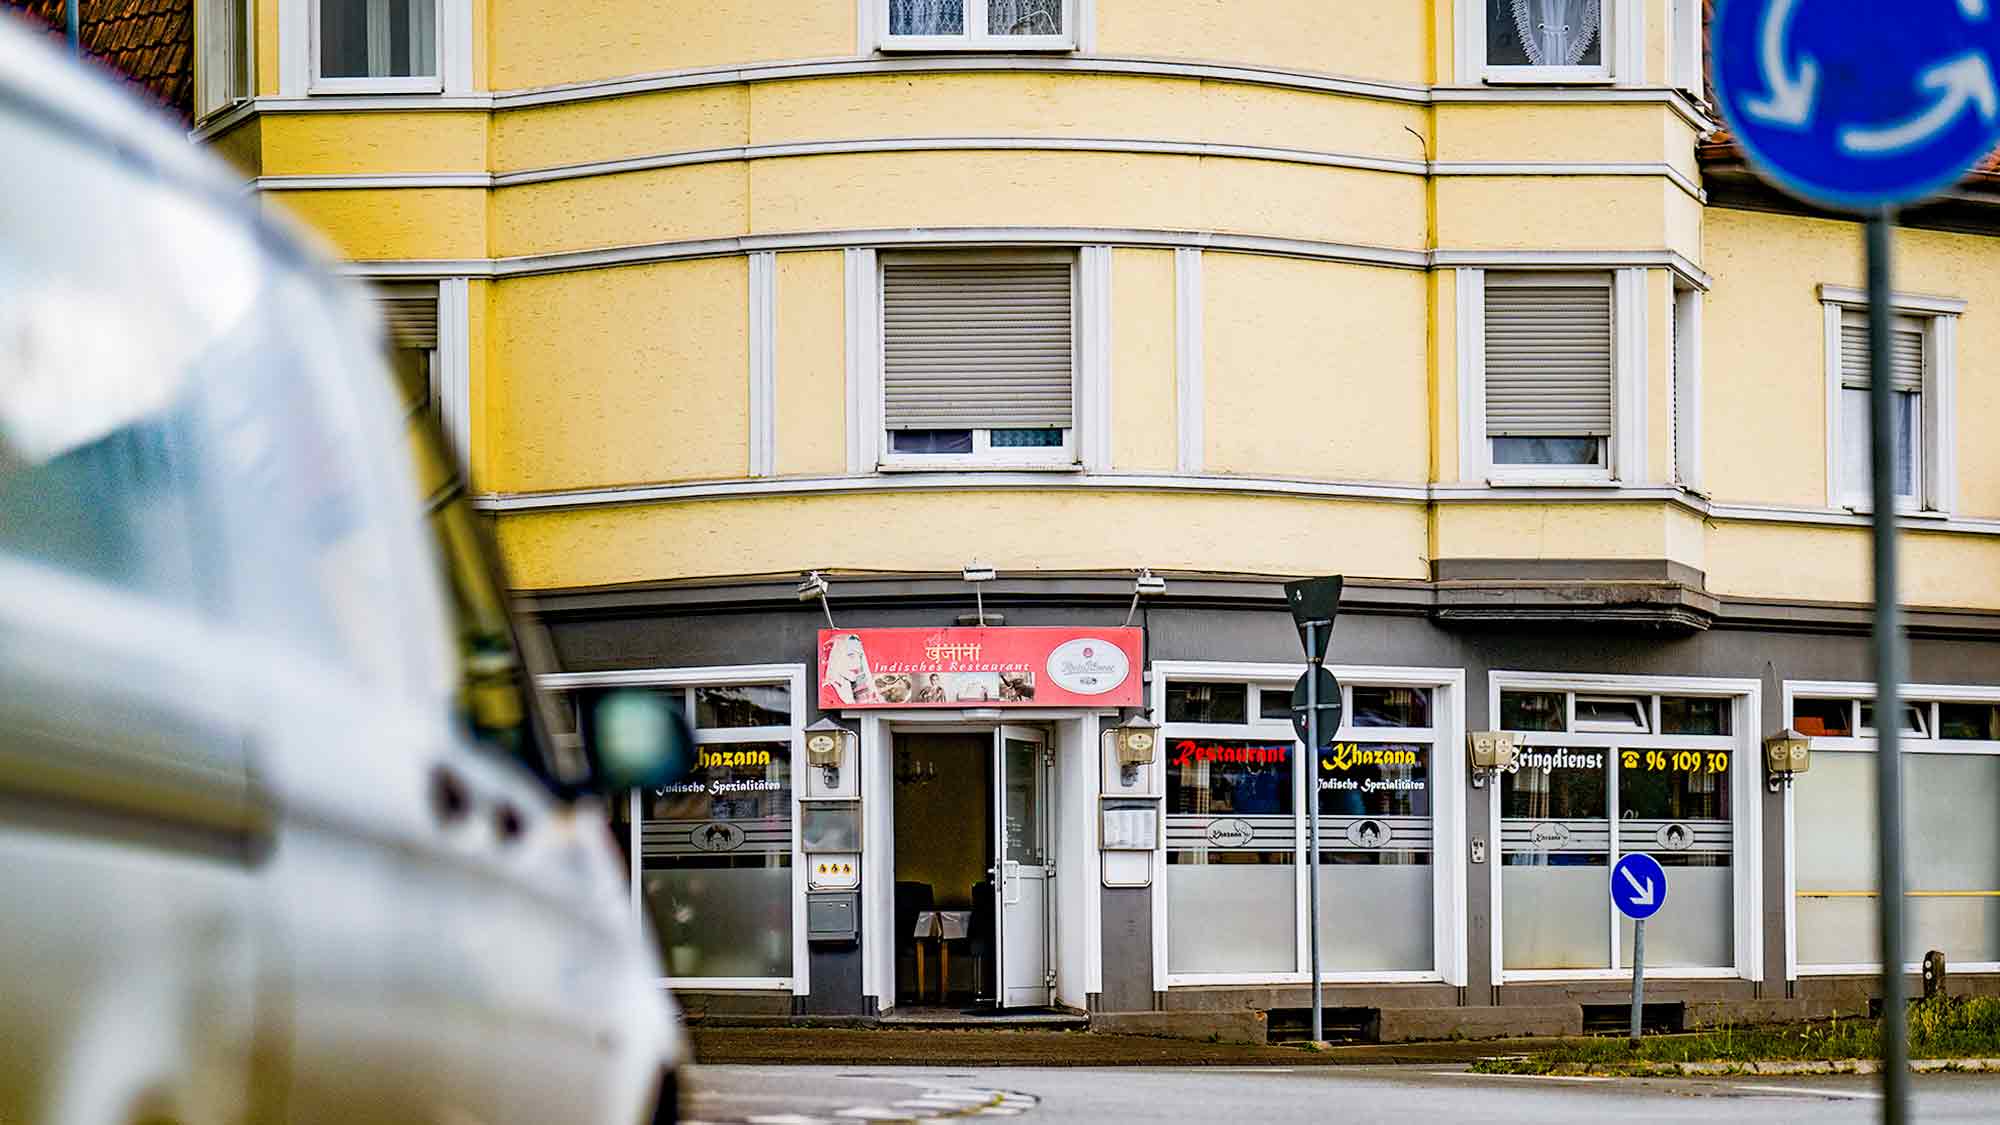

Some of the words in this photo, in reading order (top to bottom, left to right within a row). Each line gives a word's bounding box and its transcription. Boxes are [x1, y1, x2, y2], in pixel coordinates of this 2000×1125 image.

[874, 662, 943, 672] Indisches
[949, 662, 1031, 672] Restaurant
[690, 746, 771, 772] hazana
[1173, 740, 1287, 768] Restaurant
[1322, 743, 1416, 771] Khazana
[1646, 750, 1666, 771] 96
[1672, 751, 1701, 772] 109
[1706, 752, 1728, 773] 30
[708, 780, 780, 795] Spezialitäten
[1361, 778, 1424, 793] Spezialitäten
